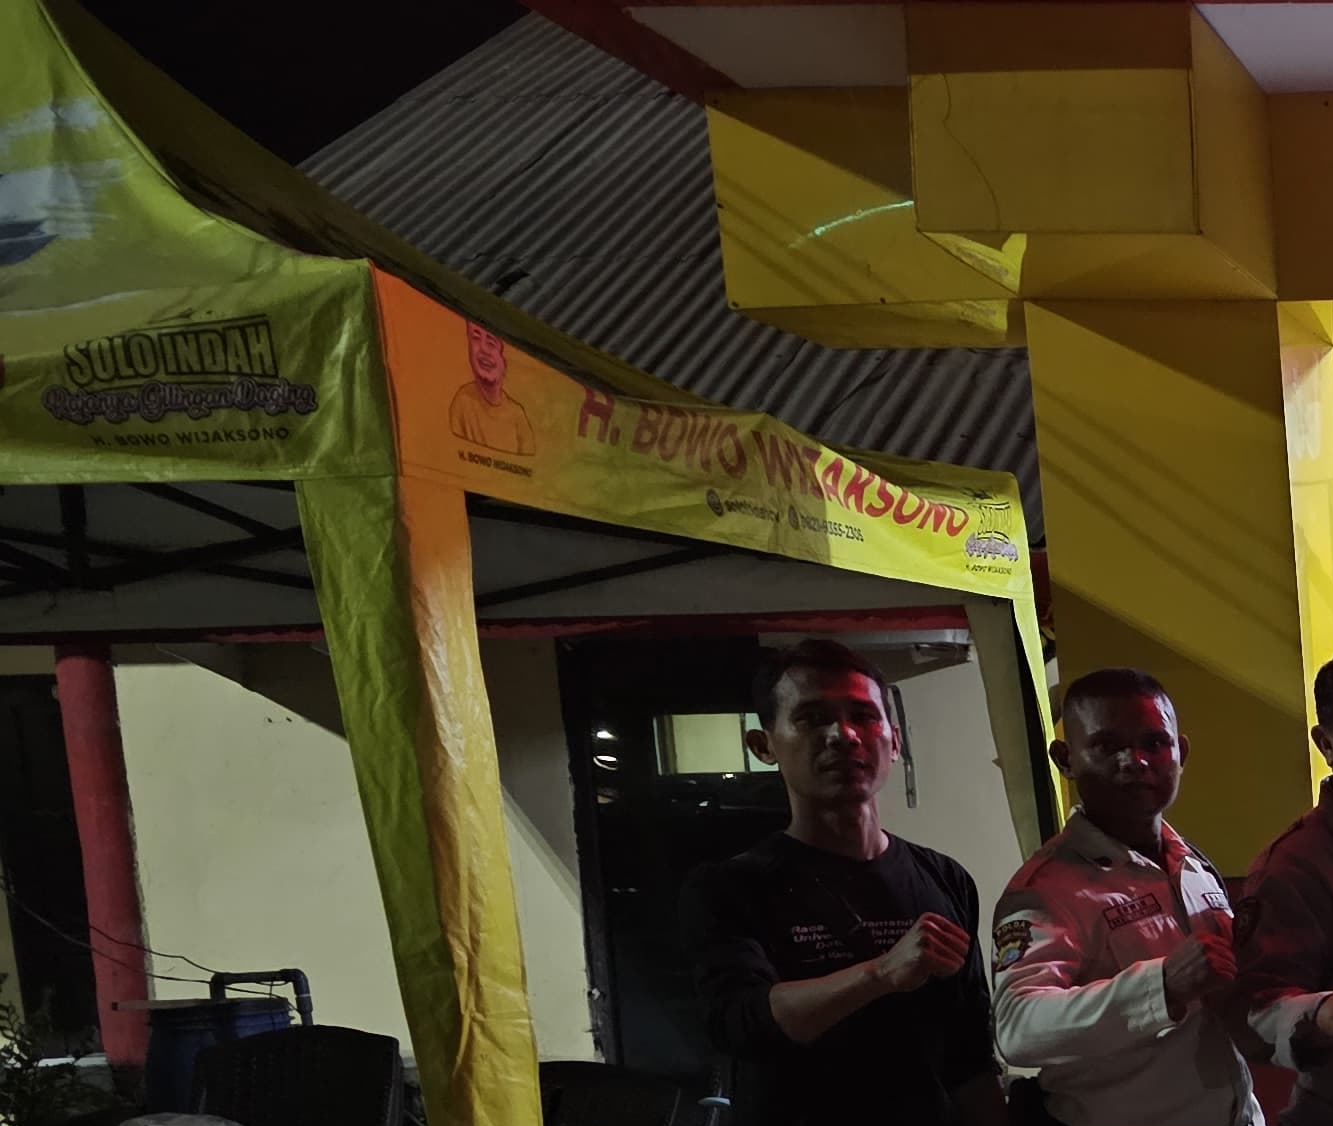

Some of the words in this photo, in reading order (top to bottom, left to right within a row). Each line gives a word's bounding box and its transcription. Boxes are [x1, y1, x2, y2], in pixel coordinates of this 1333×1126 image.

[64, 334, 159, 388] SOLO
[158, 319, 278, 378] INDAH
[118, 430, 170, 446] BOWO
[175, 426, 290, 445] WIJAKSONO
[630, 400, 748, 480] BOWO
